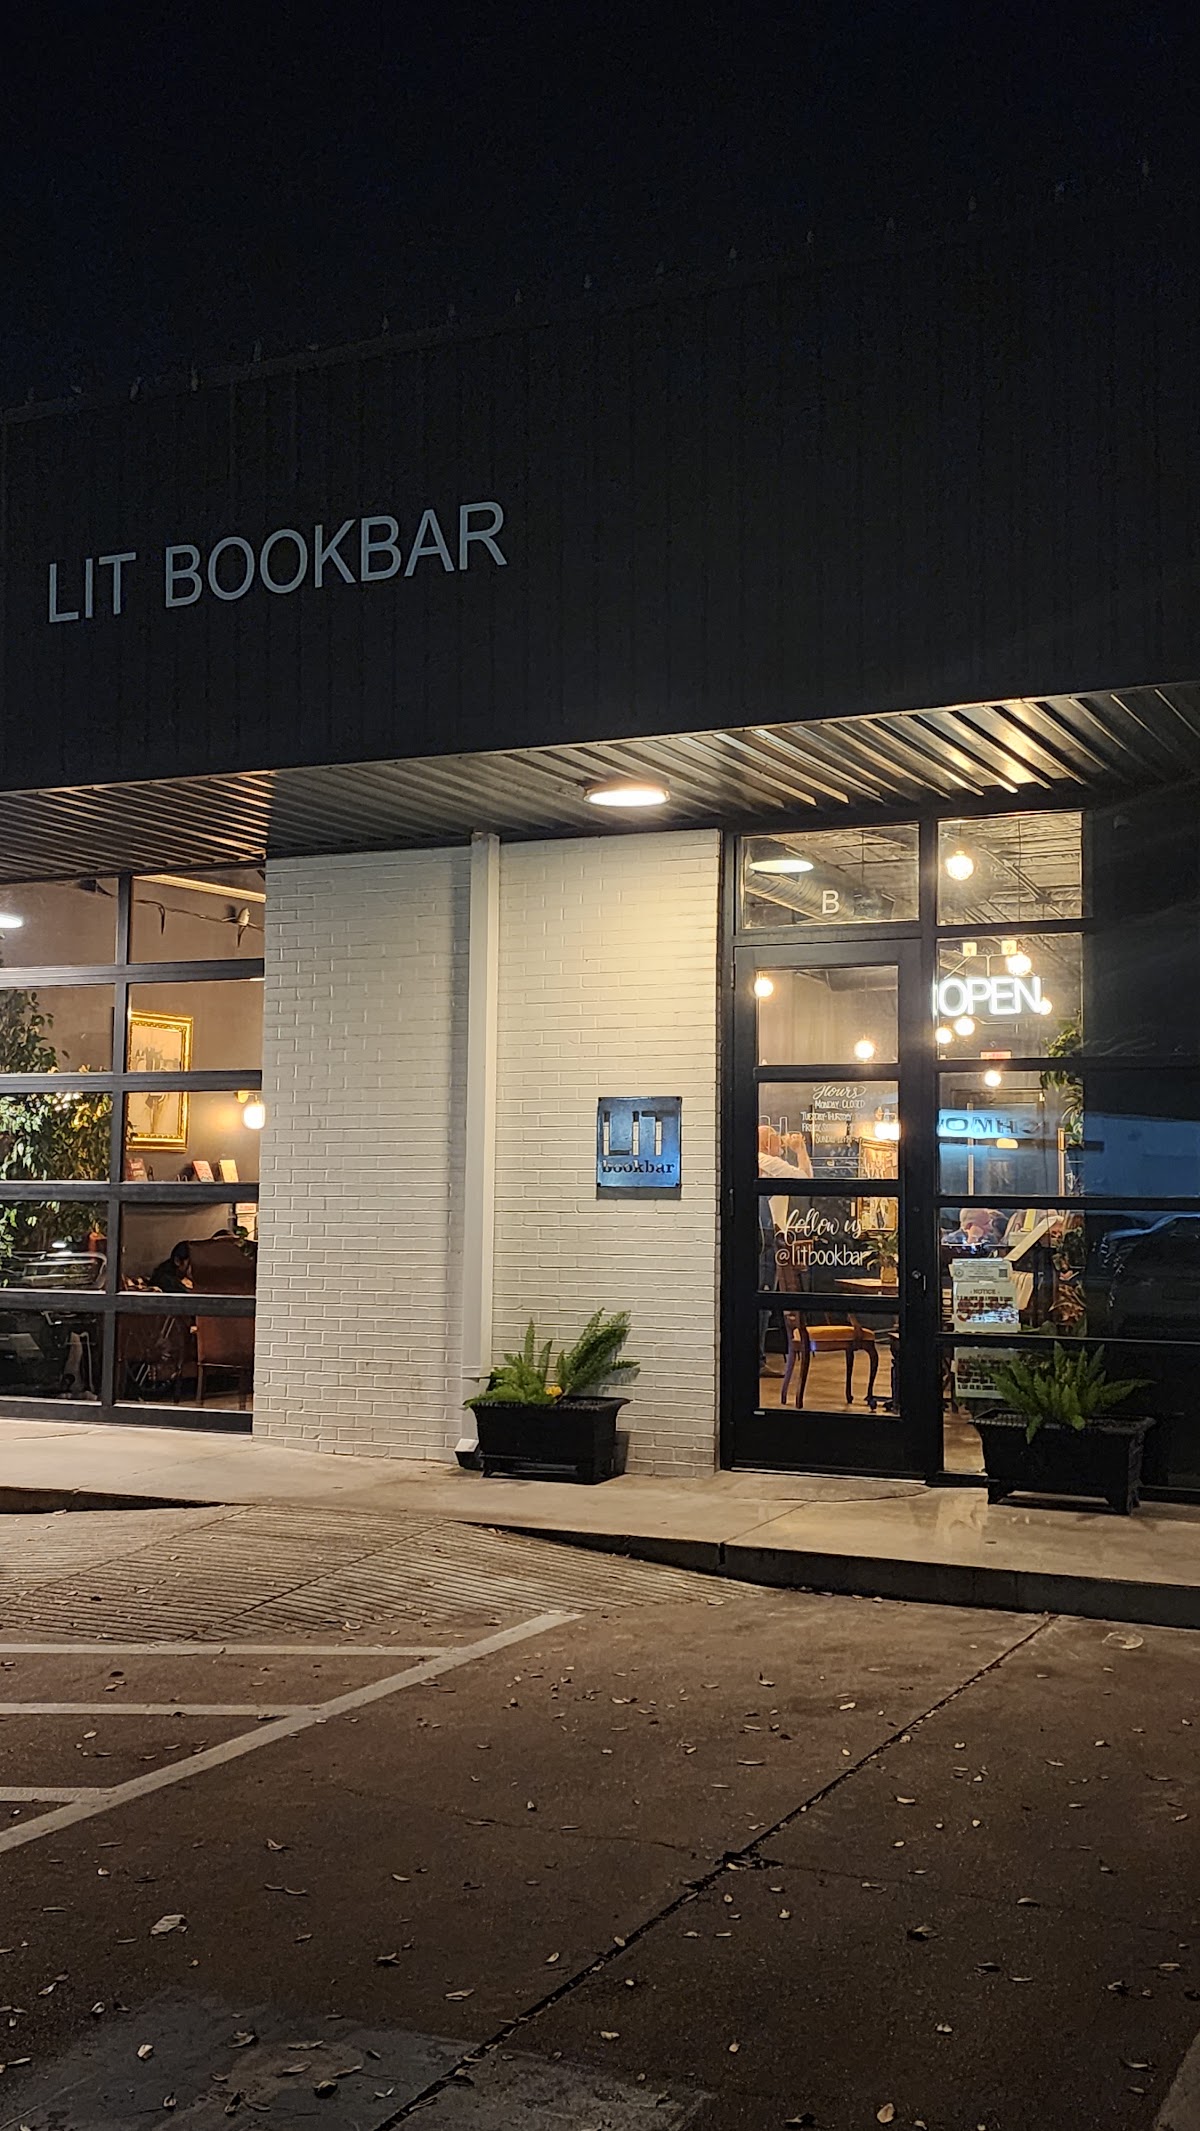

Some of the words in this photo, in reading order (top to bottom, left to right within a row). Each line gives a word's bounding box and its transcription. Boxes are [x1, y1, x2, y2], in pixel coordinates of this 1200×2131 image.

[48, 552, 137, 623] LIT
[165, 501, 508, 608] BOOKBAR
[821, 889, 839, 914] B
[938, 977, 1041, 1016] OPEN
[813, 1085, 866, 1100] Hours
[603, 1110, 675, 1156] LIT
[602, 1159, 674, 1174] bookbar
[775, 1208, 839, 1246] follow
[844, 1218, 864, 1239] us
[775, 1244, 865, 1267] @litbookbar
